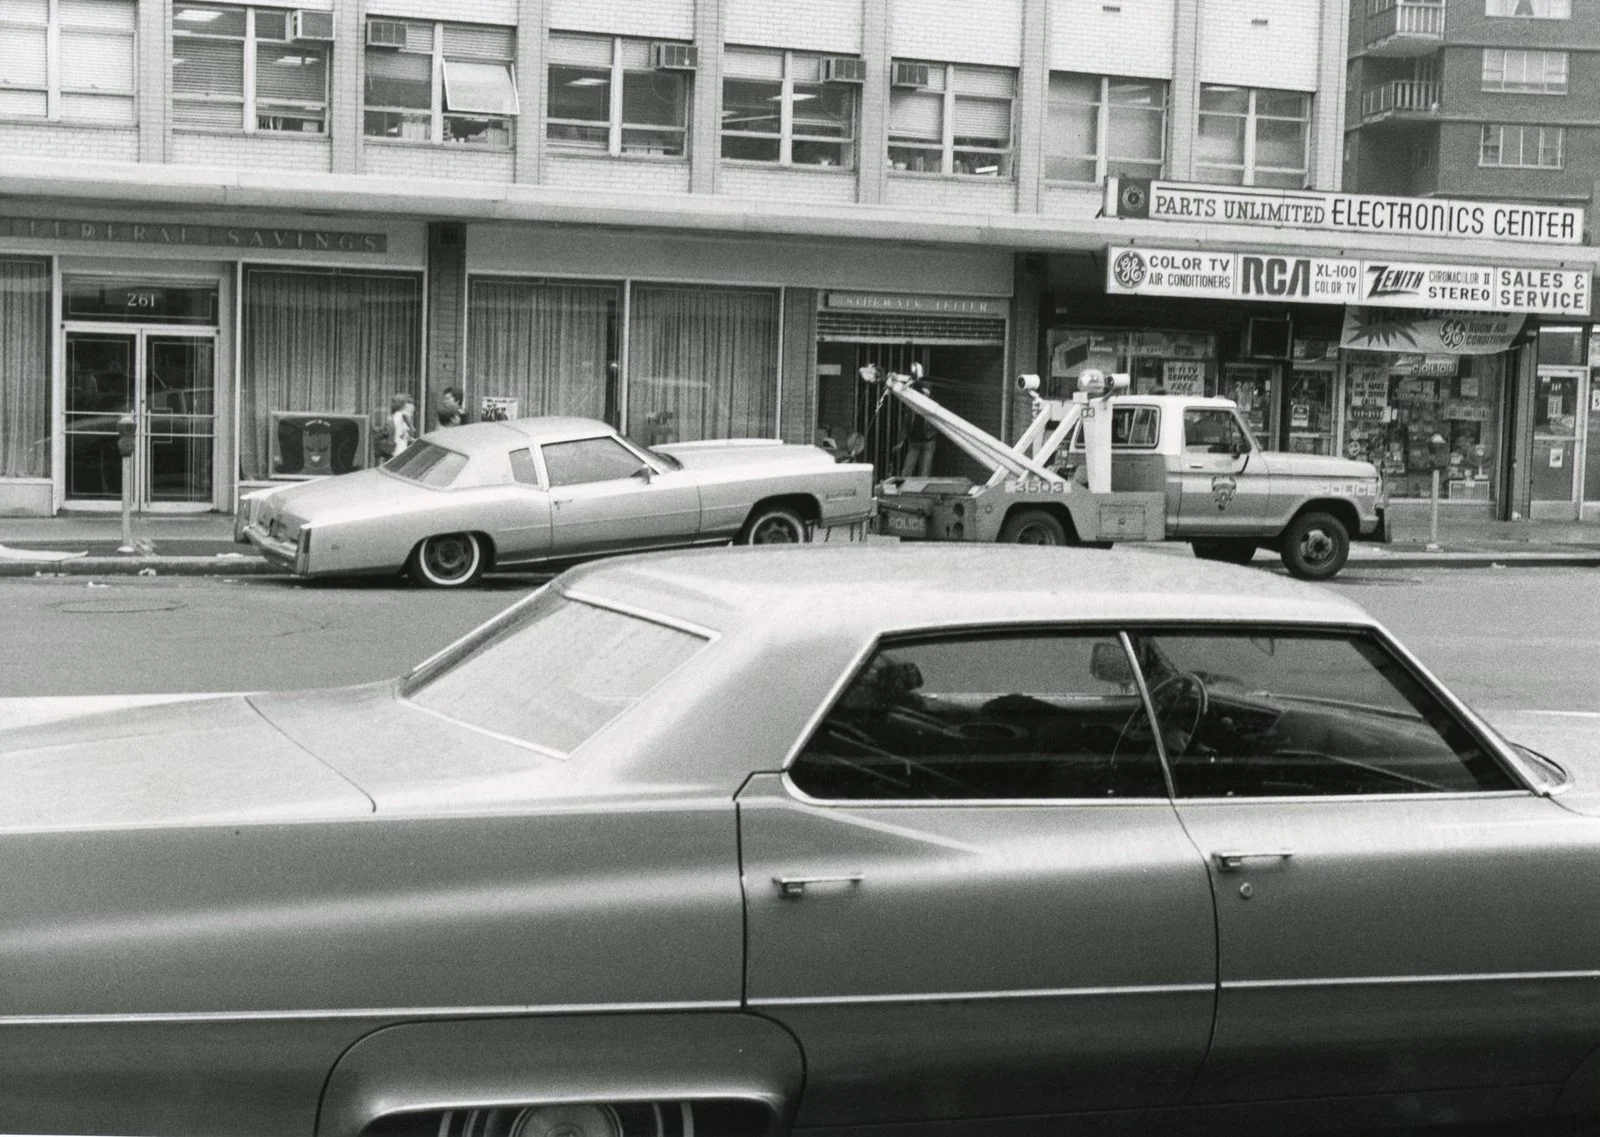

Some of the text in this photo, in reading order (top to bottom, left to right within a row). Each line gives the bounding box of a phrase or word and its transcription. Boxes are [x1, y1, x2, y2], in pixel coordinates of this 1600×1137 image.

[1154, 196, 1575, 238] PARTS UNLIMITED ELECTRONICS CENTER
[227, 229, 376, 250] SAVINGS
[1149, 256, 1230, 272] COLOR TV
[1316, 263, 1357, 278] XL-100
[1148, 273, 1231, 289] AIR CONDITIONERS
[1242, 256, 1311, 297] RCA
[1428, 270, 1480, 285] CHROMACLOR
[1501, 271, 1585, 289] SALES &
[1315, 281, 1356, 295] COLOR TV
[1428, 286, 1490, 301] STEREO
[127, 293, 154, 307] 261
[1500, 290, 1584, 309] SERVICE
